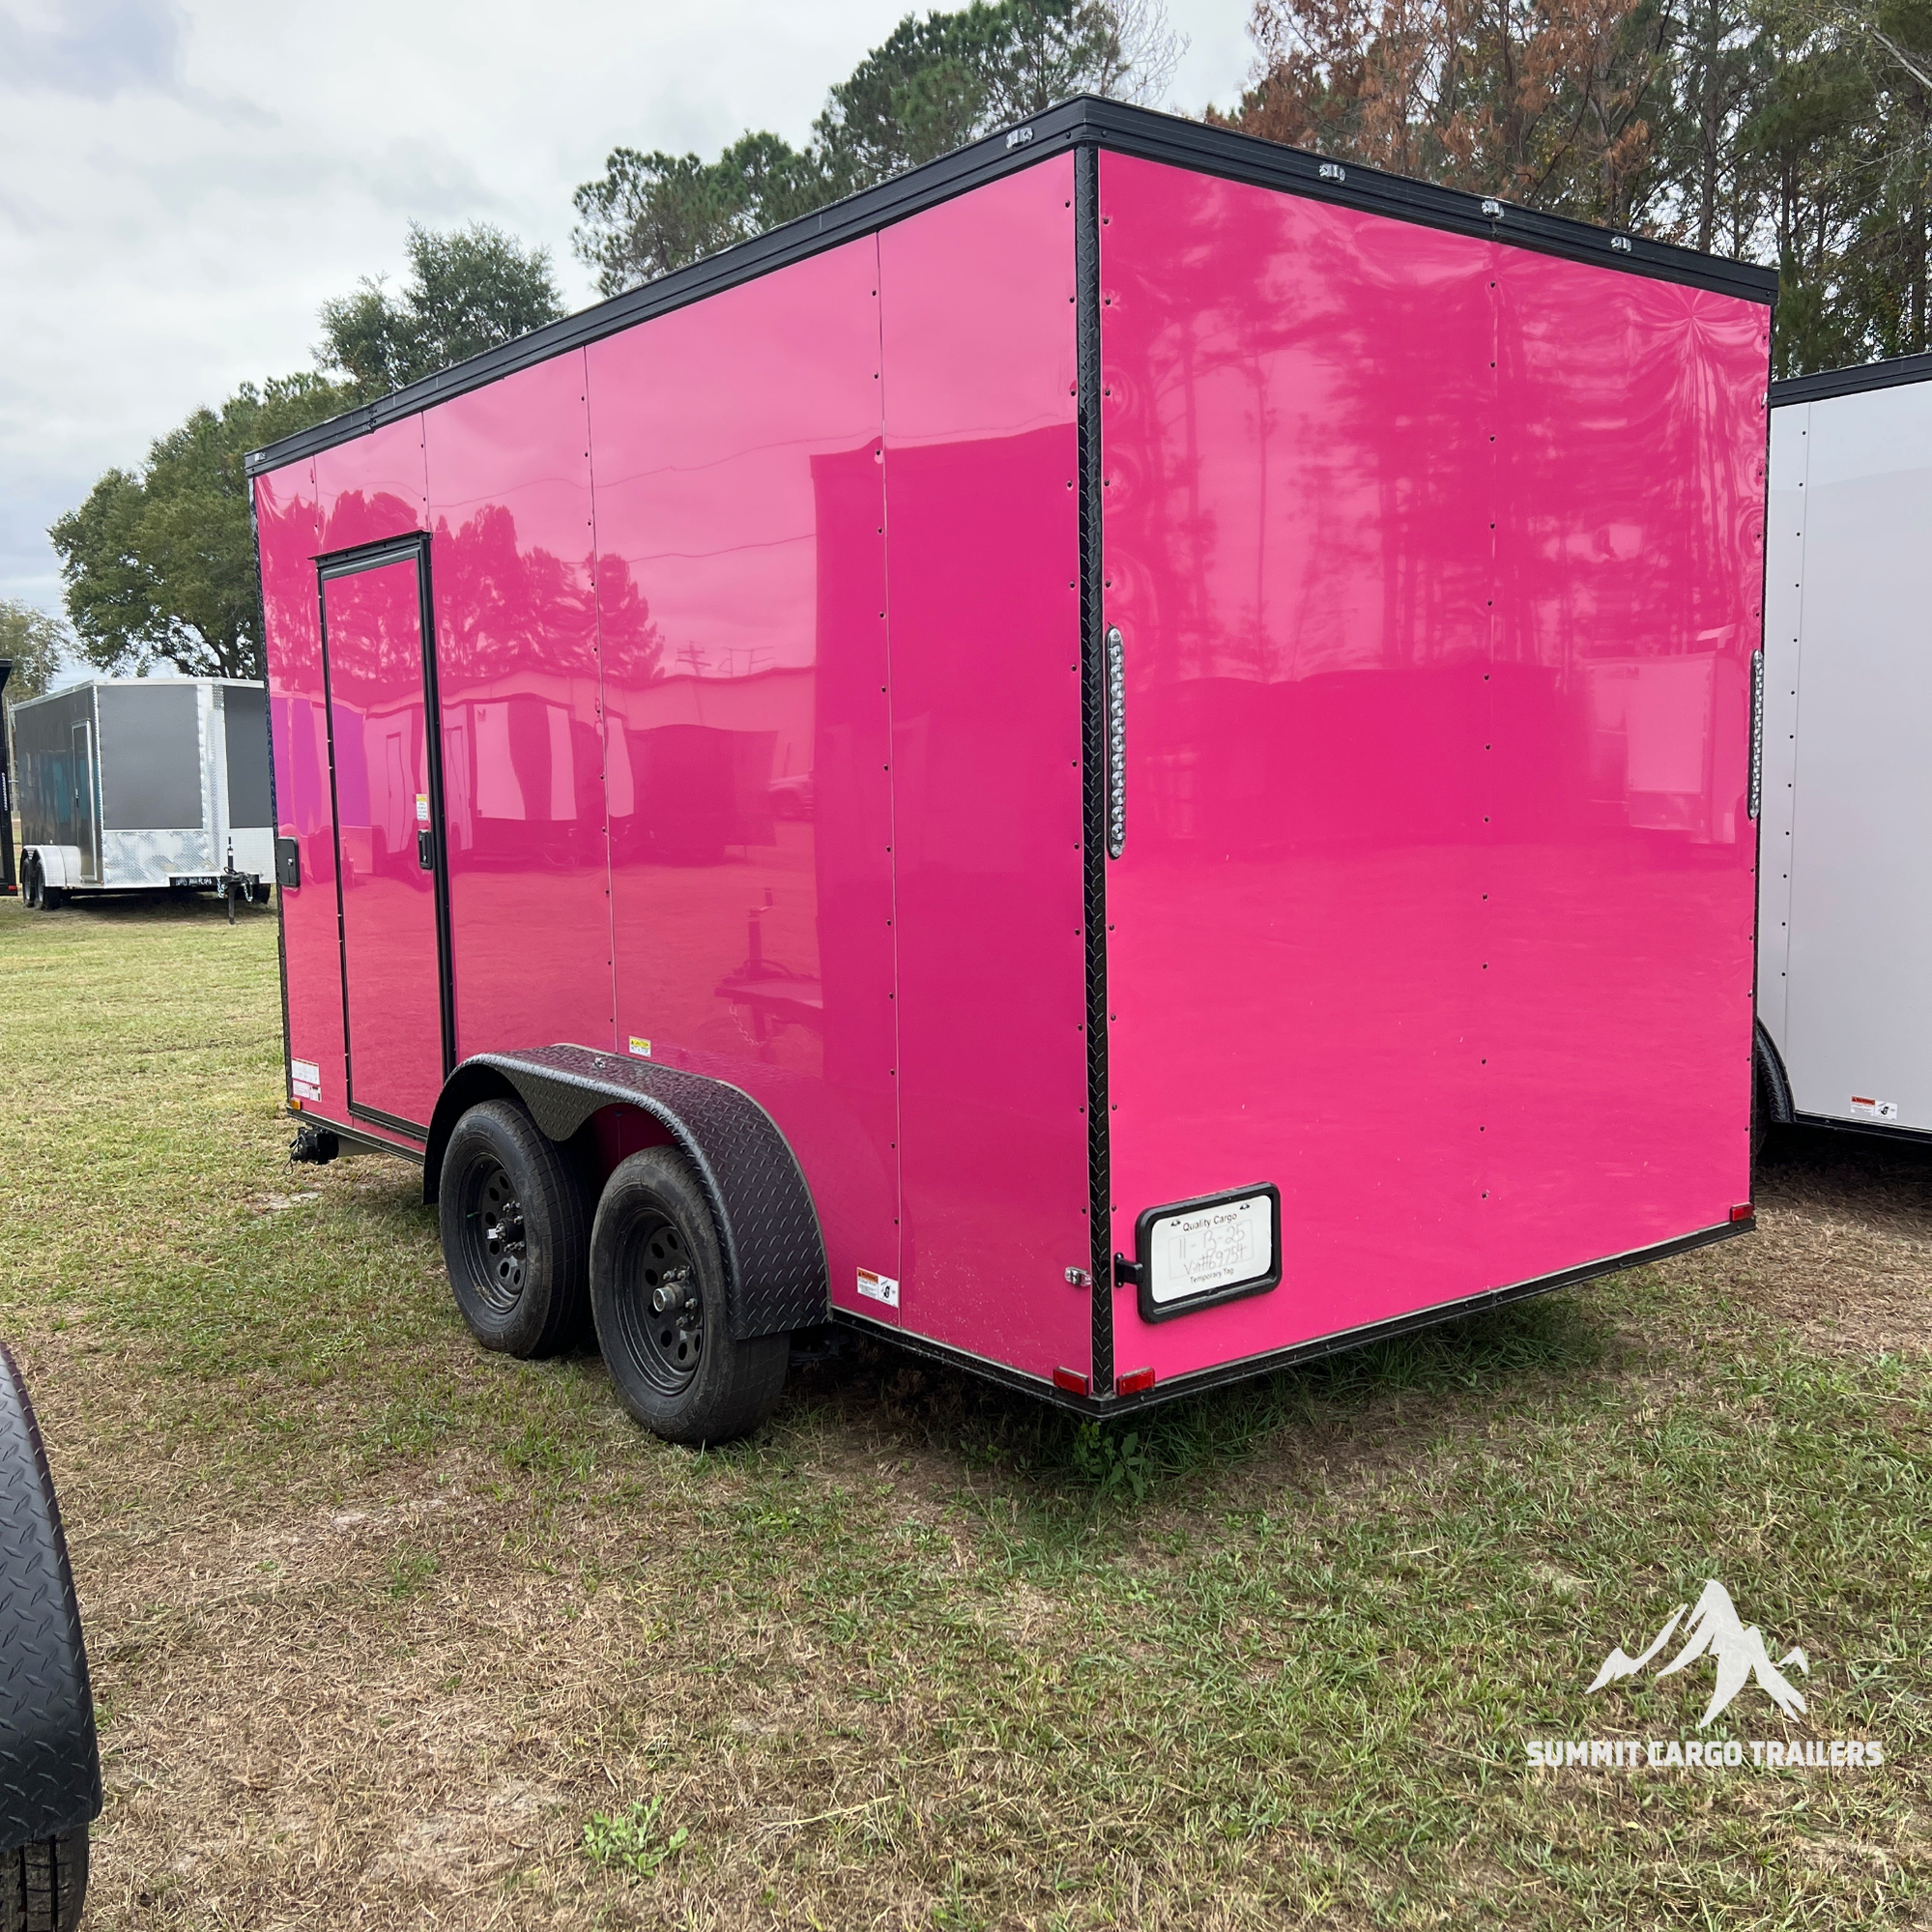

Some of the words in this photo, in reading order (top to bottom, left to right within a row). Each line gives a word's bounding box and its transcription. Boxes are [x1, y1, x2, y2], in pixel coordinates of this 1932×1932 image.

[1182, 1219, 1212, 1232] Quality
[1213, 1213, 1238, 1225] Cargo
[1190, 1270, 1223, 1284] Temporary
[1223, 1266, 1234, 1276] Tag
